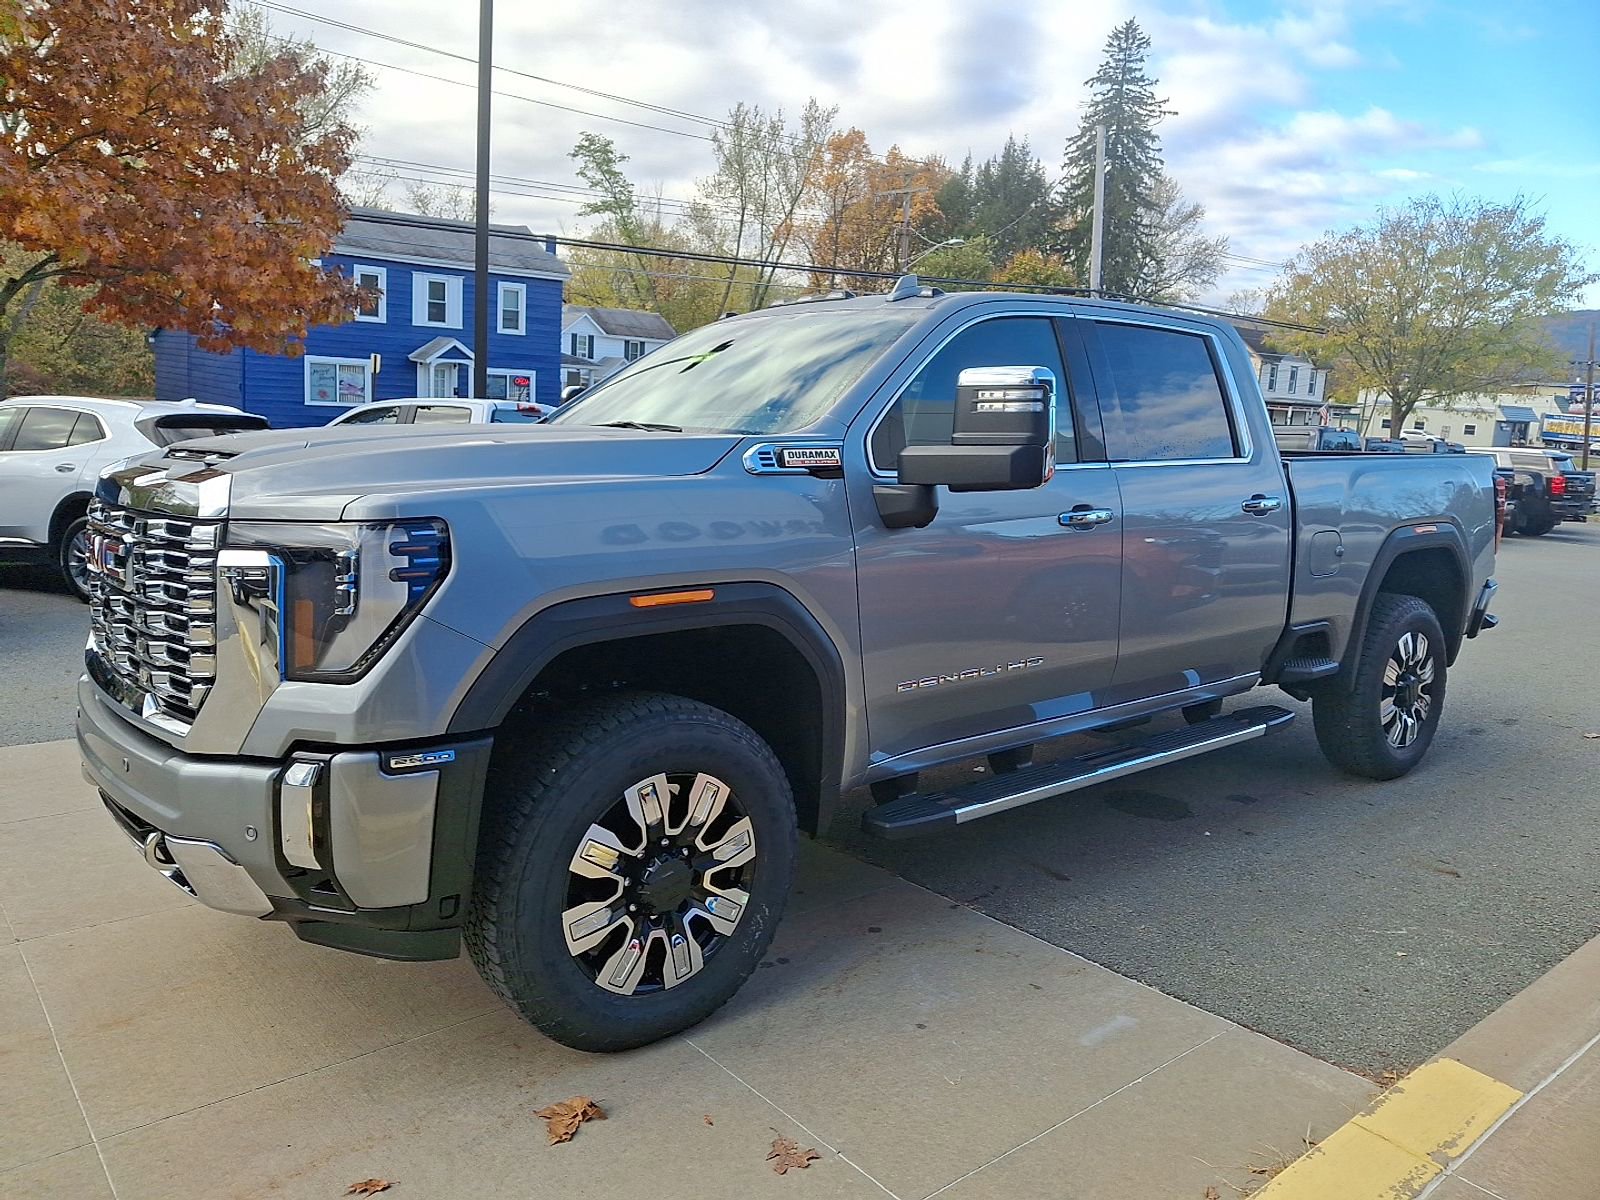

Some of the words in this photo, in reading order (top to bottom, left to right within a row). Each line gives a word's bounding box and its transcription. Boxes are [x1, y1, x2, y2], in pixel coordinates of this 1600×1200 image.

[788, 450, 837, 459] DURAMAX
[897, 664, 1002, 692] DENALI
[1007, 656, 1044, 671] HD
[391, 750, 455, 768] 2500
